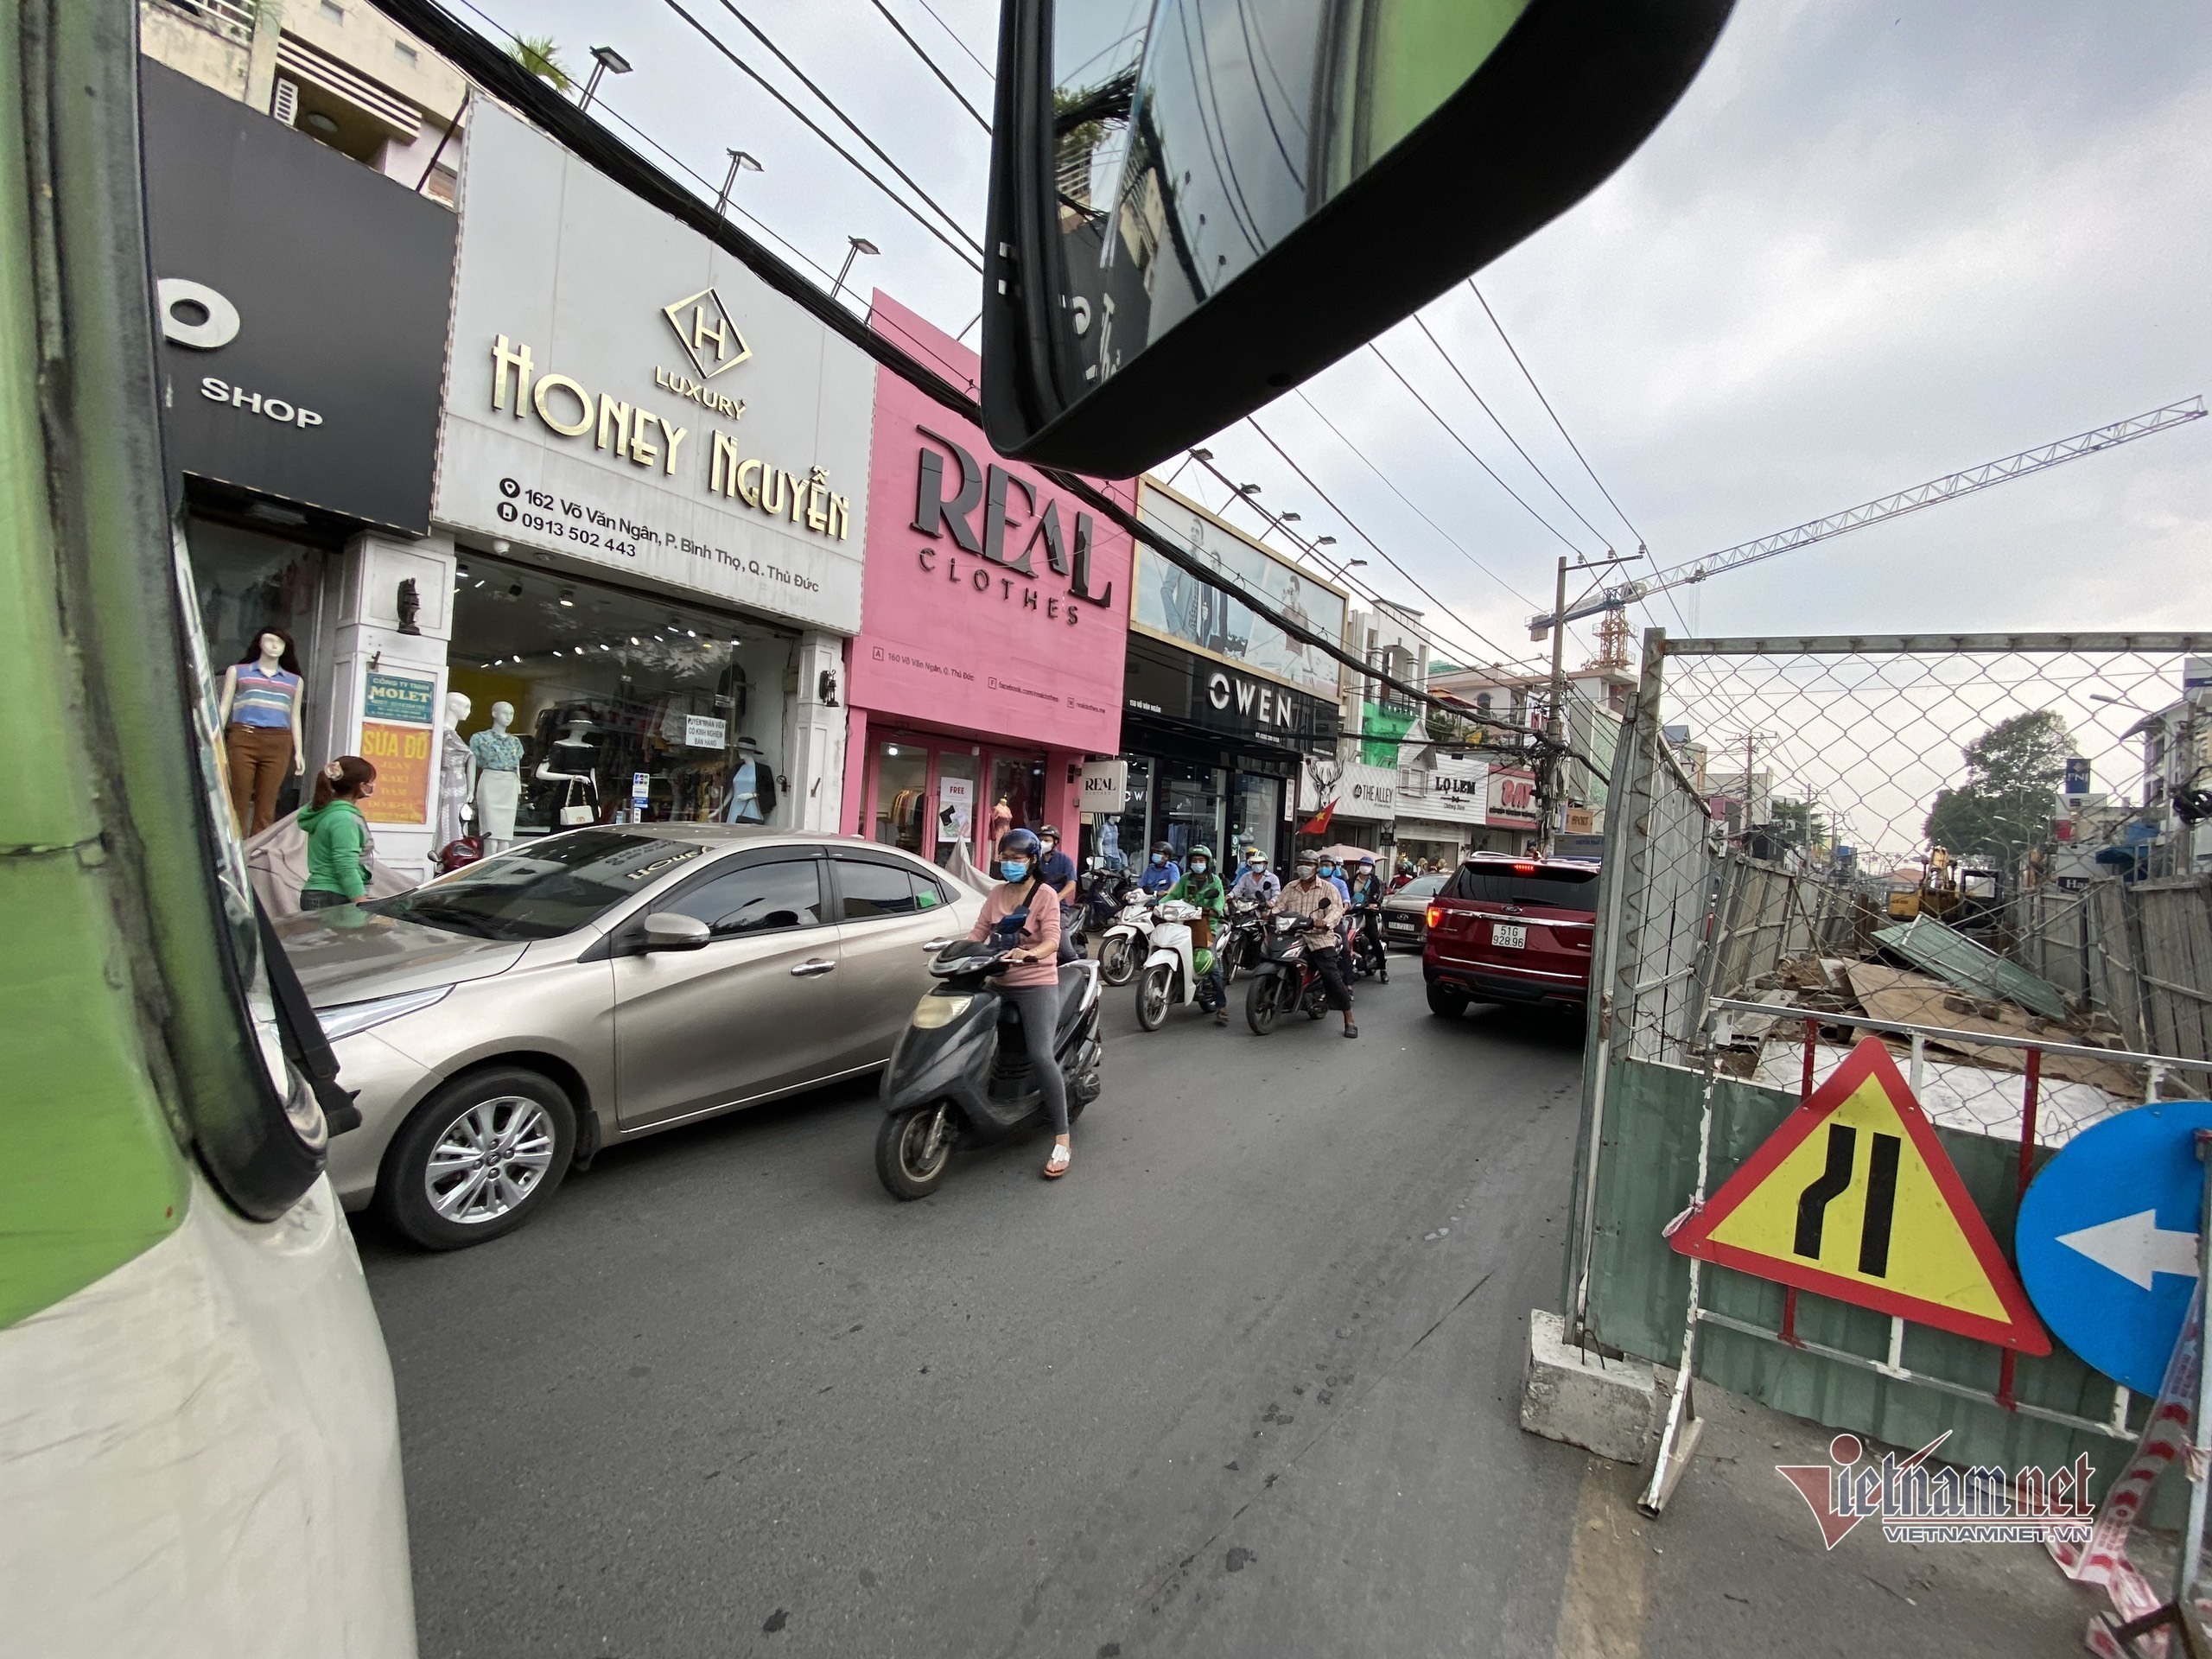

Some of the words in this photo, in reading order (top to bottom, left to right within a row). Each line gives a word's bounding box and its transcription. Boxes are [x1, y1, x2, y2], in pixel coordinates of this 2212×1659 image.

[693, 305, 727, 361] H
[200, 377, 323, 429] SHOP
[655, 365, 748, 421] LUXURY
[491, 334, 688, 476] HONEY
[710, 429, 849, 541] NGUYỄN
[522, 512, 563, 537] 0913
[568, 526, 600, 548] 502
[604, 538, 636, 557] 443
[909, 423, 1112, 608] REAL
[524, 489, 554, 512] 162
[560, 499, 582, 519] Võ
[586, 506, 616, 531] Văn
[620, 518, 662, 547] Ngân,
[665, 532, 677, 550] P.
[681, 537, 712, 560] Bình
[766, 564, 791, 584] Thủ
[793, 574, 819, 593] Đức
[919, 547, 1078, 625] CLOTHES
[888, 652, 900, 663] 160
[370, 685, 430, 702] MOLET
[1208, 672, 1292, 729] OWEN
[363, 724, 398, 757] SỬA
[950, 785, 965, 795] FREE
[1084, 778, 1116, 791] REAL
[1363, 785, 1375, 802] THE
[1375, 786, 1394, 804] ALLEY
[1493, 935, 1524, 949] 928.96
[1500, 925, 1518, 938] 51G
